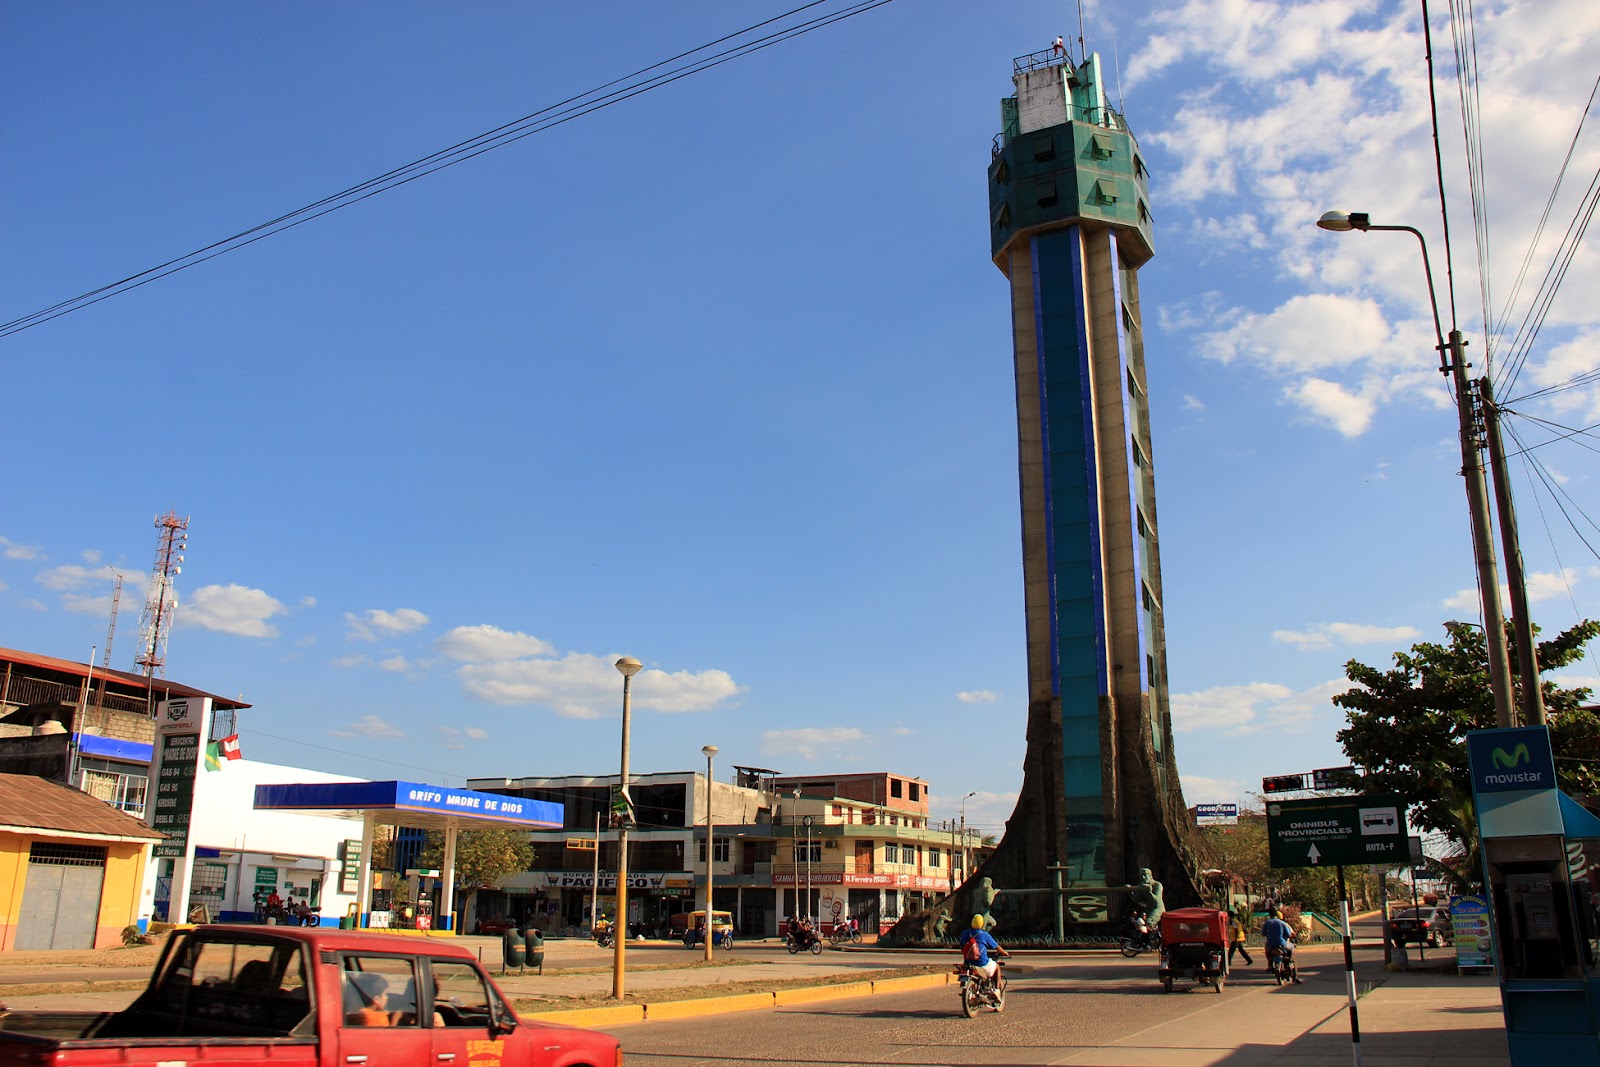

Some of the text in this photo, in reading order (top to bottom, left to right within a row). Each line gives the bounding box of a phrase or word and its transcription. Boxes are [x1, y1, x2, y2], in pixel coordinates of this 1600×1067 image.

[162, 768, 172, 776] GAS
[1485, 772, 1542, 785] movistar
[160, 783, 170, 791] GAS
[409, 789, 523, 813] GRIFO MADRE DE DIOS
[1290, 820, 1339, 829] OMNIBUS
[1278, 827, 1353, 837] PROVINCIALES
[157, 847, 180, 856] 24 Horas
[1365, 842, 1394, 852] RUTA-F
[562, 877, 648, 888] PACIFCO
